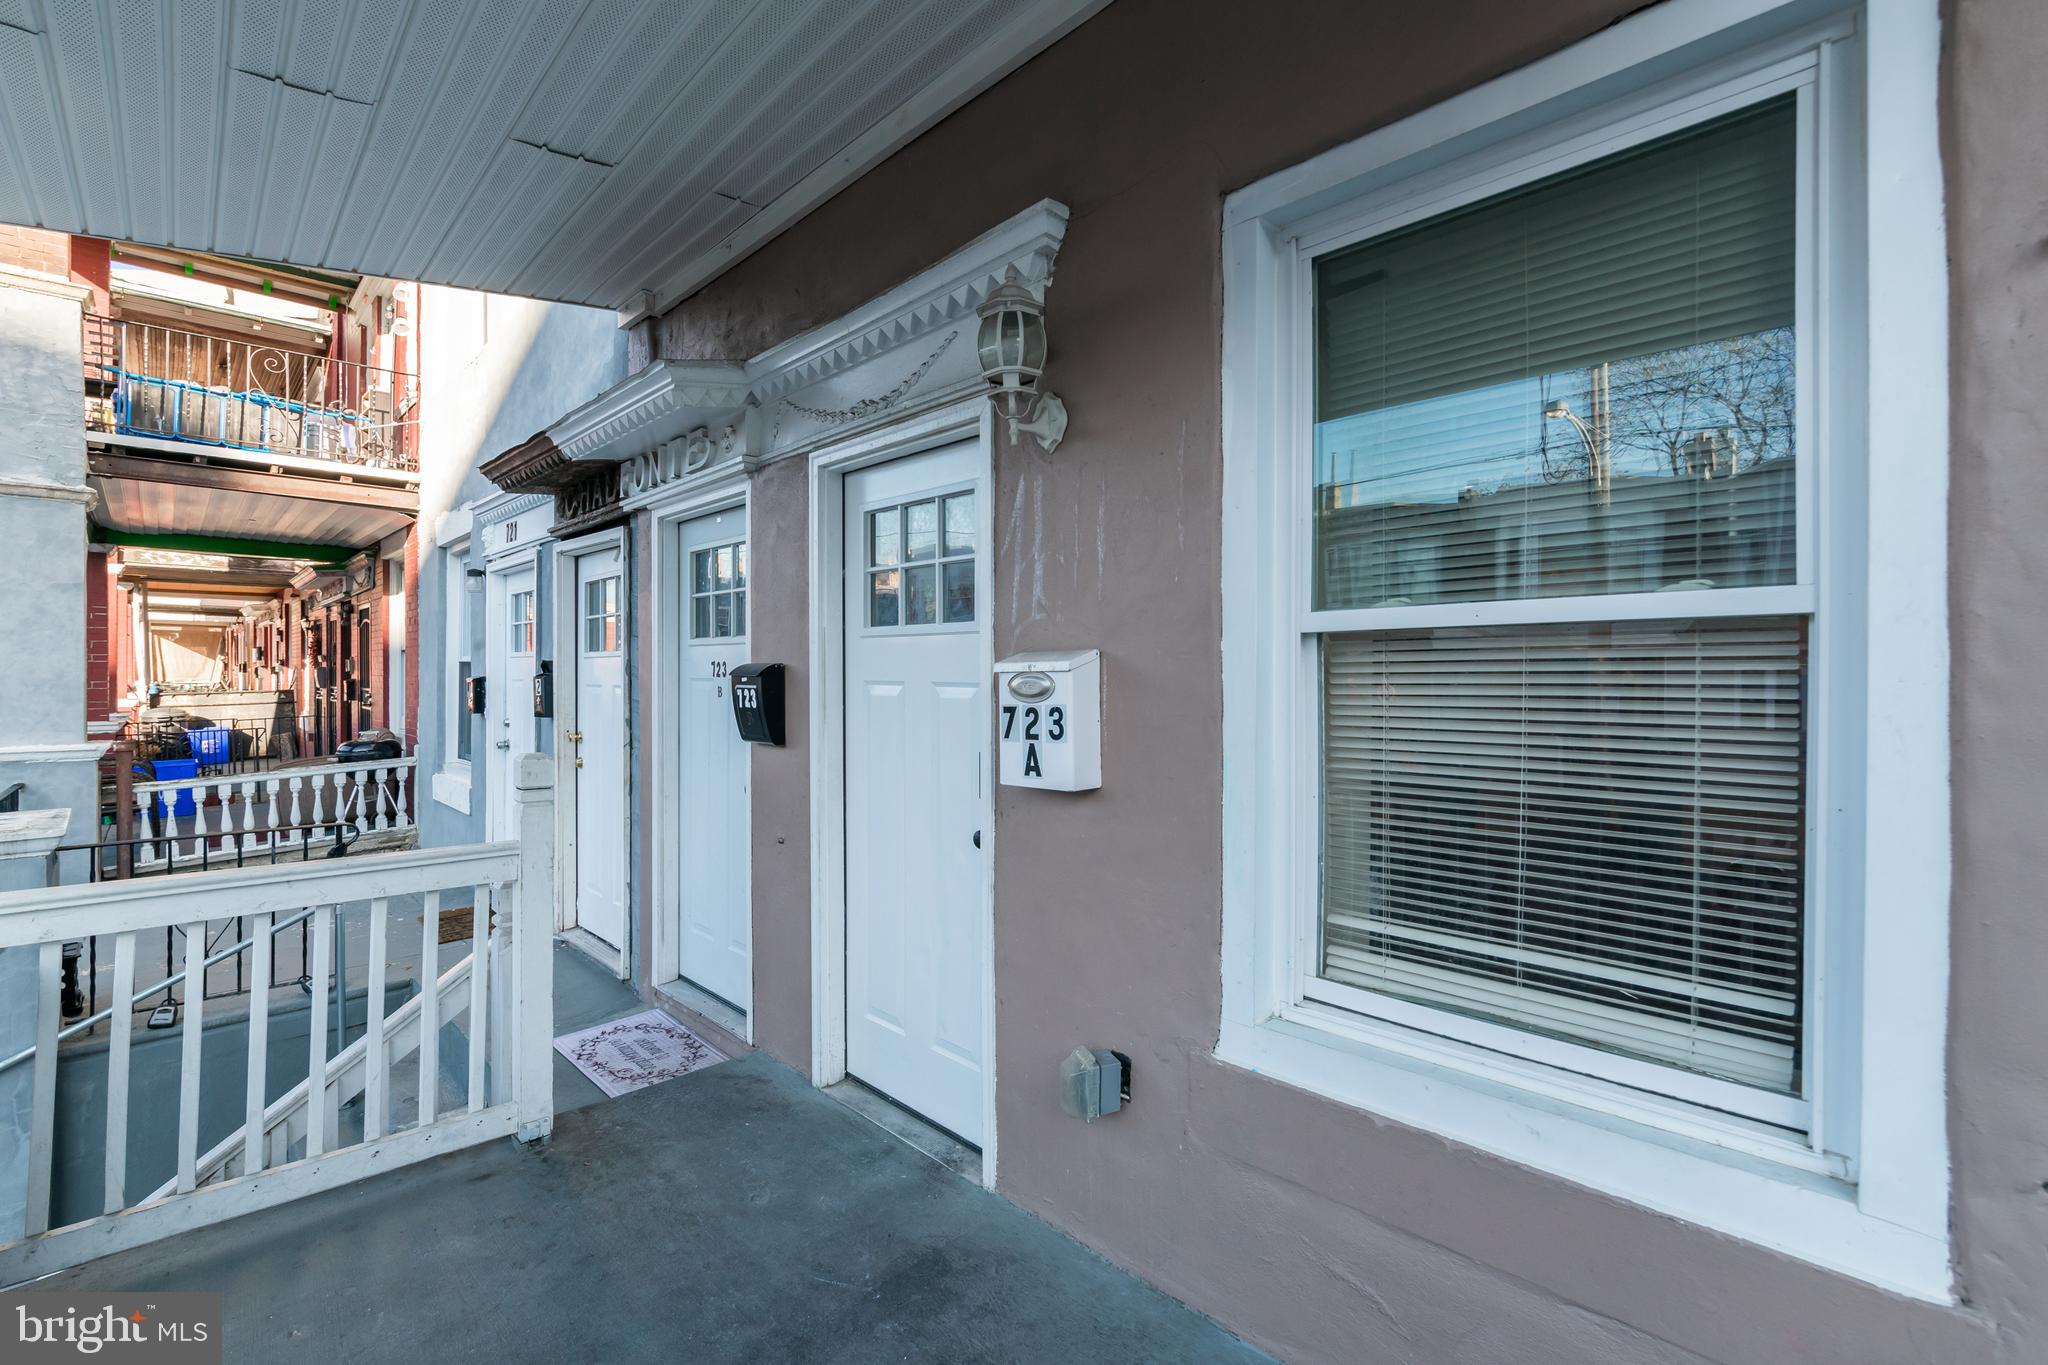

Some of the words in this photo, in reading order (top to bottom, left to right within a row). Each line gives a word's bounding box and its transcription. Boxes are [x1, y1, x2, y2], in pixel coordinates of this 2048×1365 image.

[711, 661, 727, 678] 723
[717, 686, 723, 698] B
[736, 688, 757, 708] 723
[1003, 706, 1065, 741] 723
[1024, 743, 1042, 777] A
